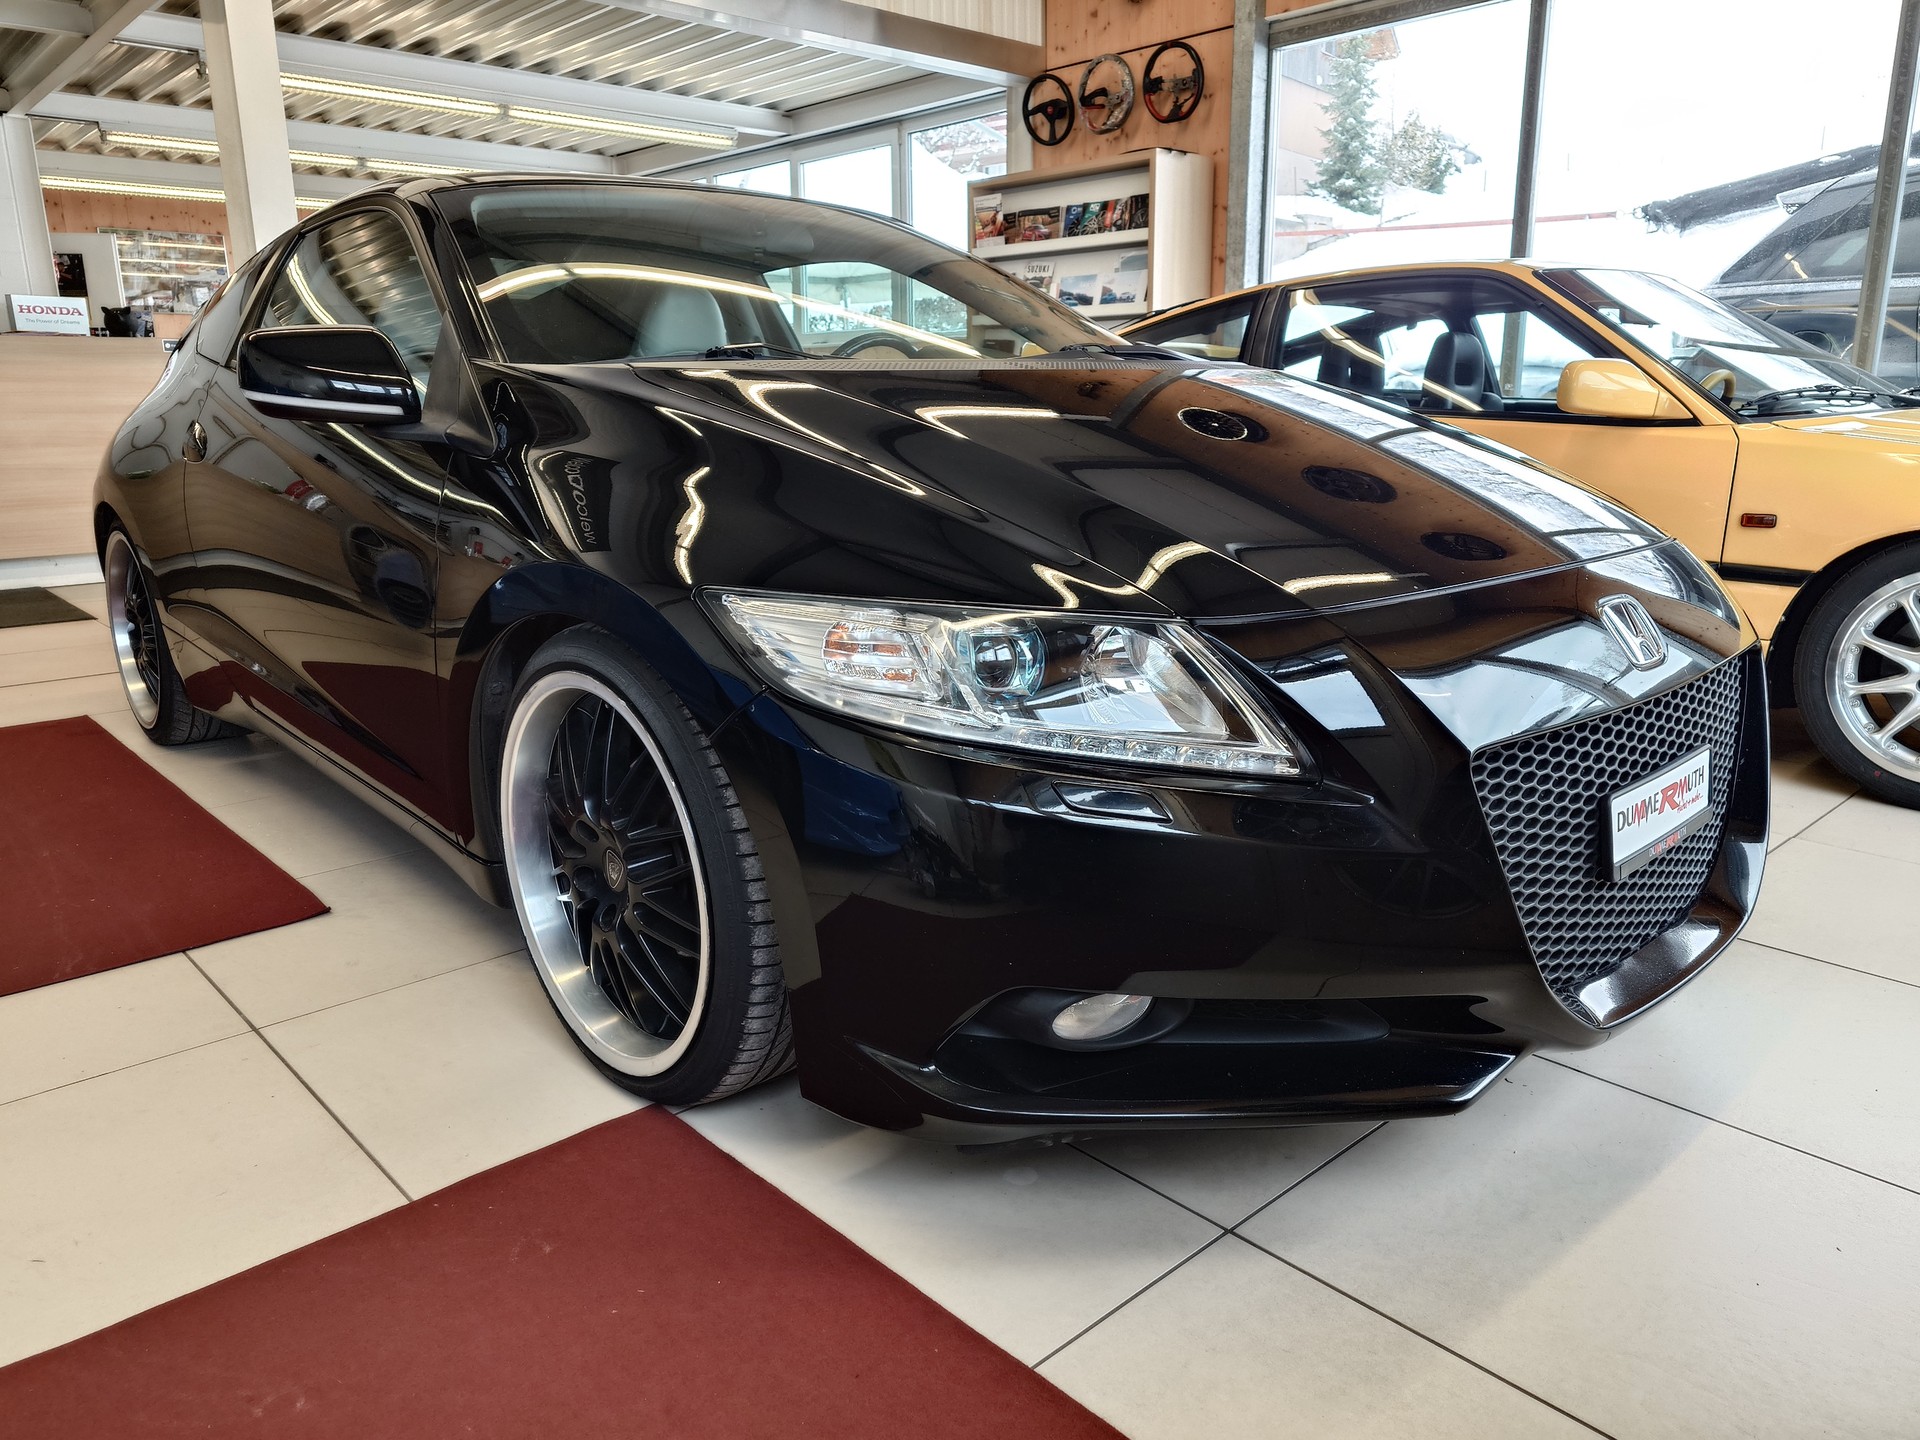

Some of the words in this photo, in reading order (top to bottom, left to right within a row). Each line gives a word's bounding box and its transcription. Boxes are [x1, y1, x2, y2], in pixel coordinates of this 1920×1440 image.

[1027, 264, 1050, 274] SUZUKI
[17, 304, 84, 317] HONDA
[1617, 765, 1705, 833] DUMMERMUTH
